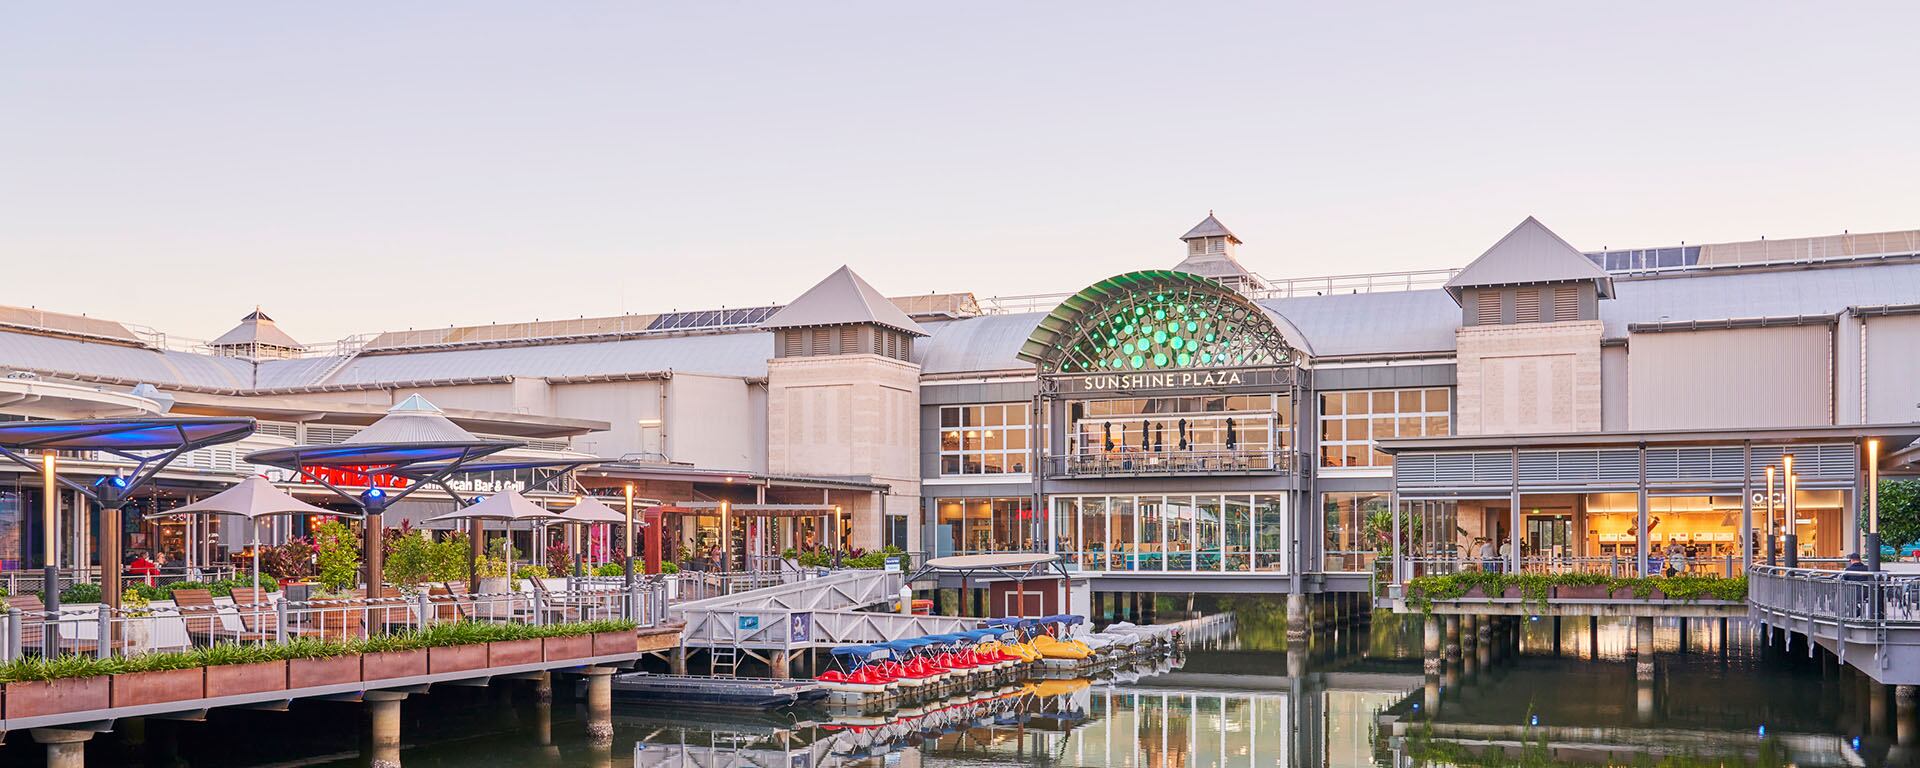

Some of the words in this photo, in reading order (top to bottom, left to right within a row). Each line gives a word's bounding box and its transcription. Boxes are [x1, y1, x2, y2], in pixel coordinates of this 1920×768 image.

[1084, 373, 1175, 390] SUNSHINE
[1182, 371, 1241, 387] PLAZA
[474, 479, 494, 491] Bar
[495, 480, 503, 492] &
